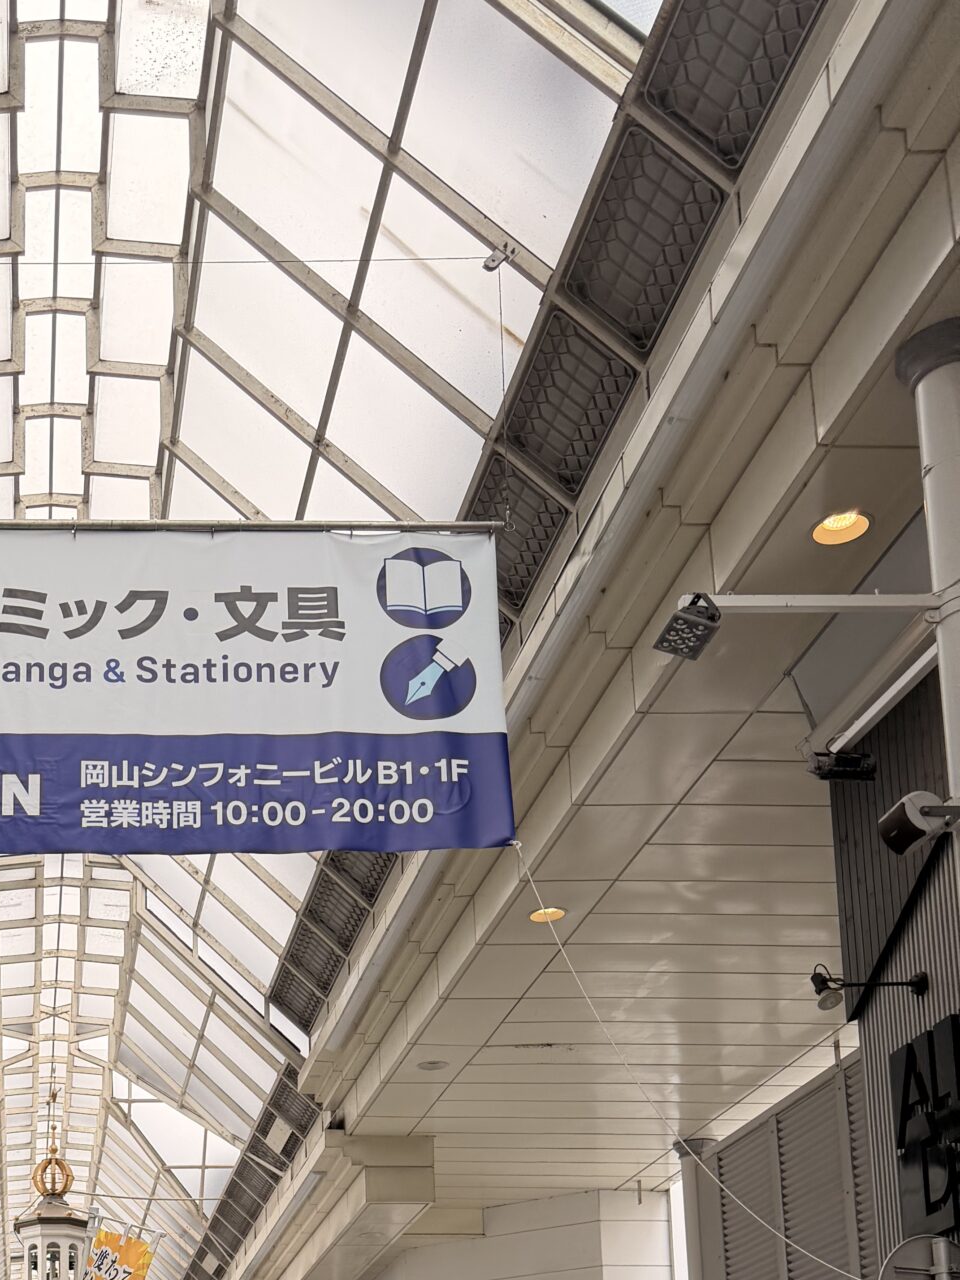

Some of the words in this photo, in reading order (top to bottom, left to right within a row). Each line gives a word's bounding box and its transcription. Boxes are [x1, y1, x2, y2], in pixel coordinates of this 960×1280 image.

[104, 659, 125, 682] &
[137, 655, 339, 688] Stationery
[81, 800, 200, 828] 営業時間
